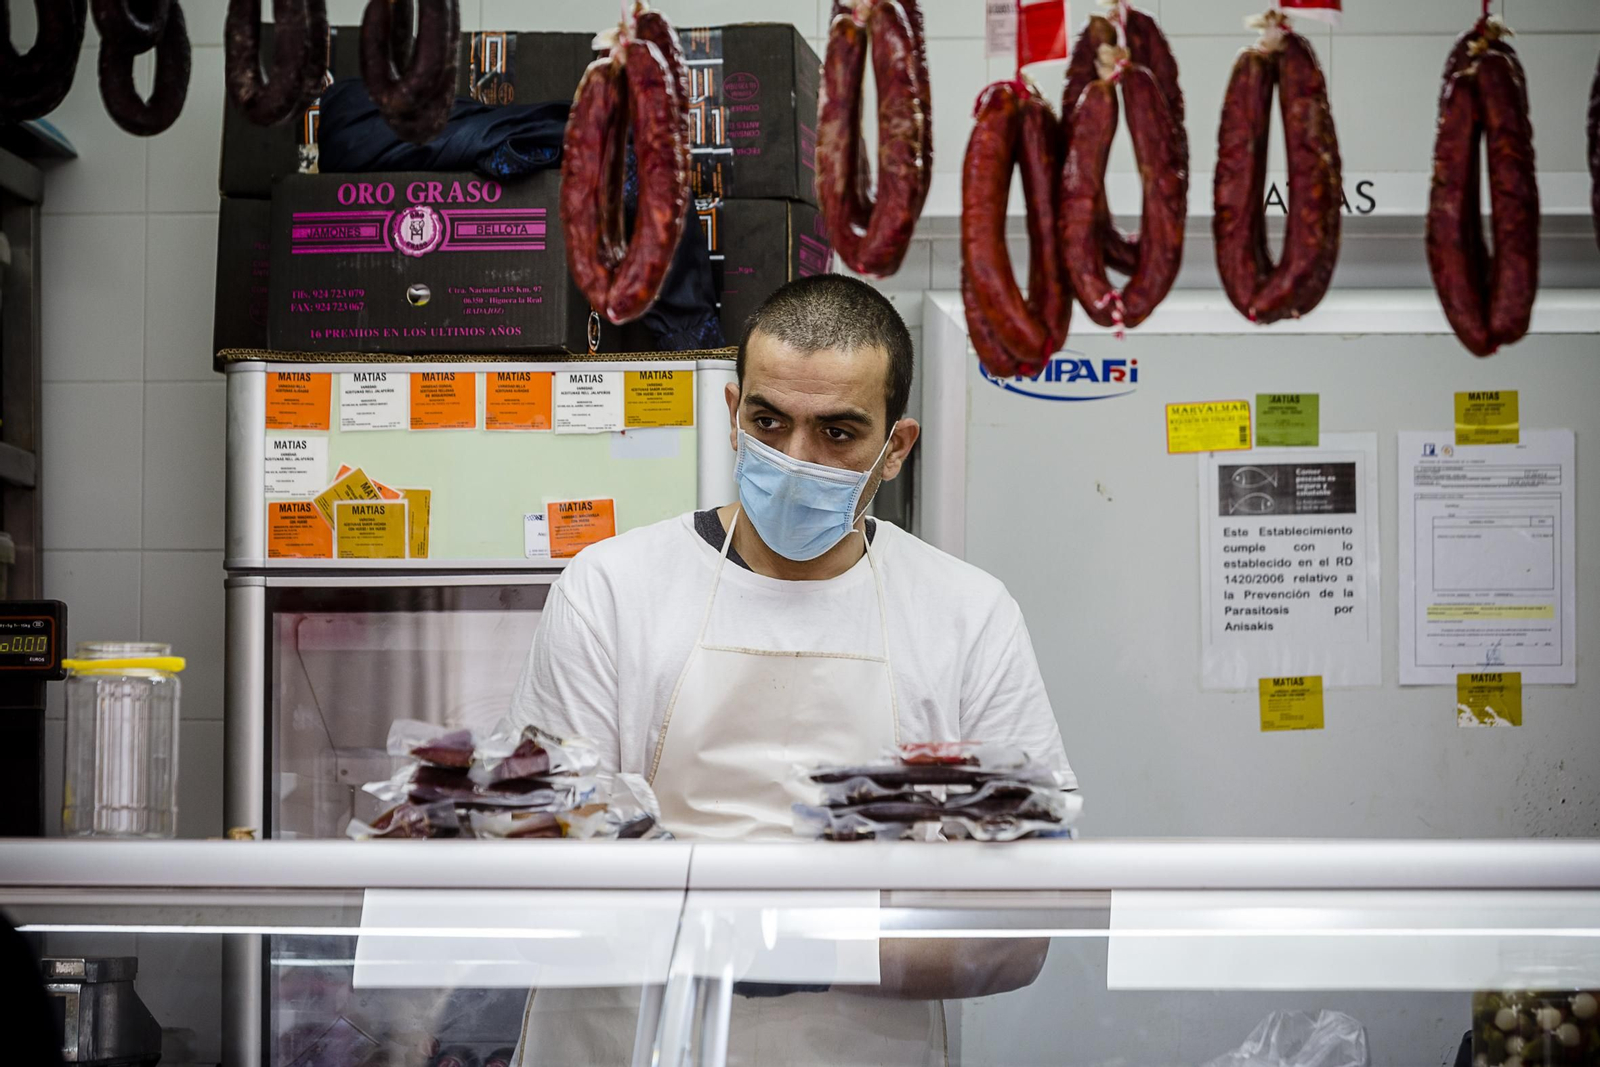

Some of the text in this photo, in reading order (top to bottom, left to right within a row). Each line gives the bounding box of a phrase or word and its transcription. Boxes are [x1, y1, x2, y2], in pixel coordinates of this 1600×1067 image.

[337, 180, 502, 206] ORO GRASO
[307, 227, 361, 239] JAMONES
[476, 224, 528, 236] BELLOTA
[312, 289, 329, 299] 924
[331, 289, 347, 298] 723
[348, 288, 365, 298] 079
[448, 286, 467, 294] Ctra.
[469, 286, 500, 294] Nacional
[489, 296, 517, 305] Higuera
[290, 302, 365, 312] FAX: 924 723 067
[463, 307, 504, 315] (BADAJOZ)
[310, 325, 522, 339] 16 PREMIOS EN LOS ULTIMOS AÑOS
[278, 372, 311, 382] MATIAS
[353, 372, 387, 382] MATIAS
[422, 372, 455, 381] MATIAS
[497, 372, 531, 381] MATIAS
[569, 374, 603, 384] MATIAS
[639, 370, 673, 380] MATIAS
[1468, 392, 1500, 401] MATIAS
[1171, 403, 1248, 415] MARVALMAR
[273, 440, 307, 450] MATIAS
[279, 503, 311, 513] MATIAS
[352, 505, 386, 515] MATIAS
[559, 501, 593, 512] MATIAS
[1223, 525, 1353, 537] Este Establecimiento
[1223, 541, 1353, 554] cumple con lo
[1223, 556, 1353, 568] establecido en el RD
[1224, 573, 1353, 584] 1420/2006 relativo a
[1224, 588, 1354, 600] la Prevención de la
[1224, 605, 1354, 616] Parasitosis por
[1225, 621, 1274, 631] Anisakis
[12, 636, 47, 652] 0.00
[1272, 677, 1304, 686] MATIAS
[1471, 673, 1503, 683] MATIAS
